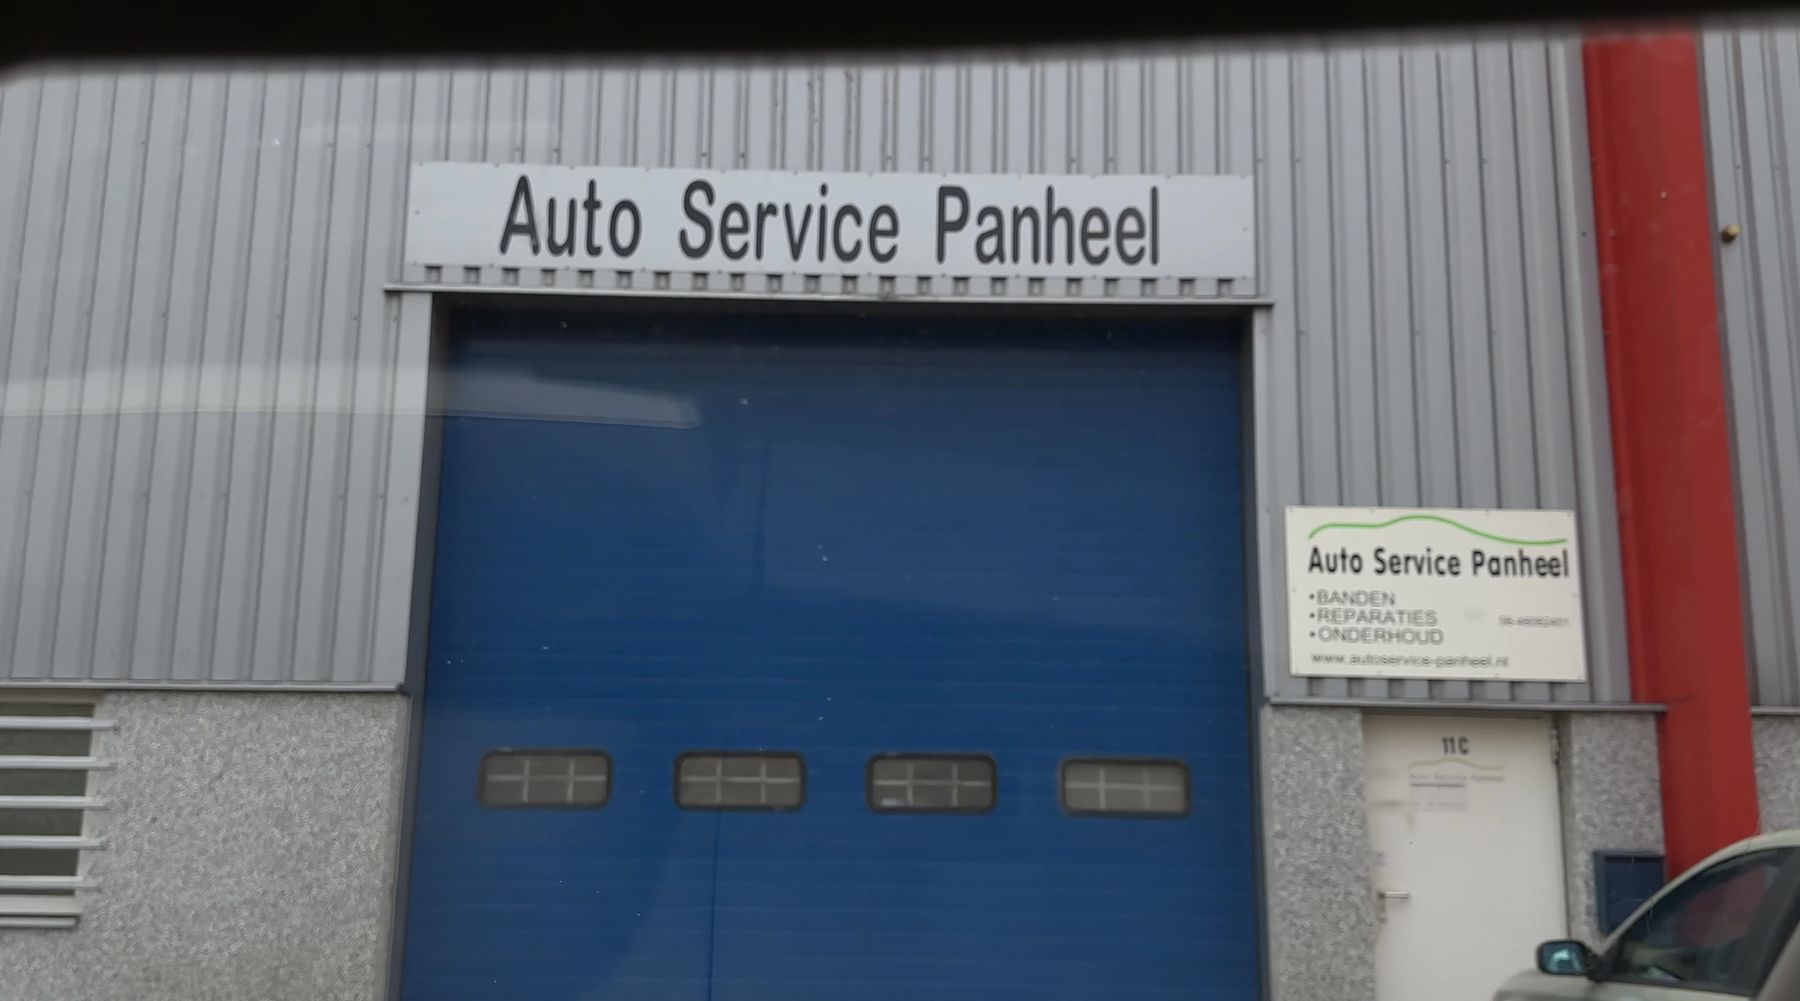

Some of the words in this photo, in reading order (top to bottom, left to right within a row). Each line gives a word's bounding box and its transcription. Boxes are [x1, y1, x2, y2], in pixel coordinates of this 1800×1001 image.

[499, 174, 642, 257] Auto
[678, 179, 900, 263] Service
[936, 185, 1160, 266] Panheel
[1308, 546, 1363, 574] Auto
[1374, 547, 1461, 576] Service
[1471, 548, 1569, 578] Panheel
[1316, 589, 1397, 606] BANDEN
[1316, 608, 1438, 627] REPARATIES
[1317, 626, 1444, 646] ONDERHOUD
